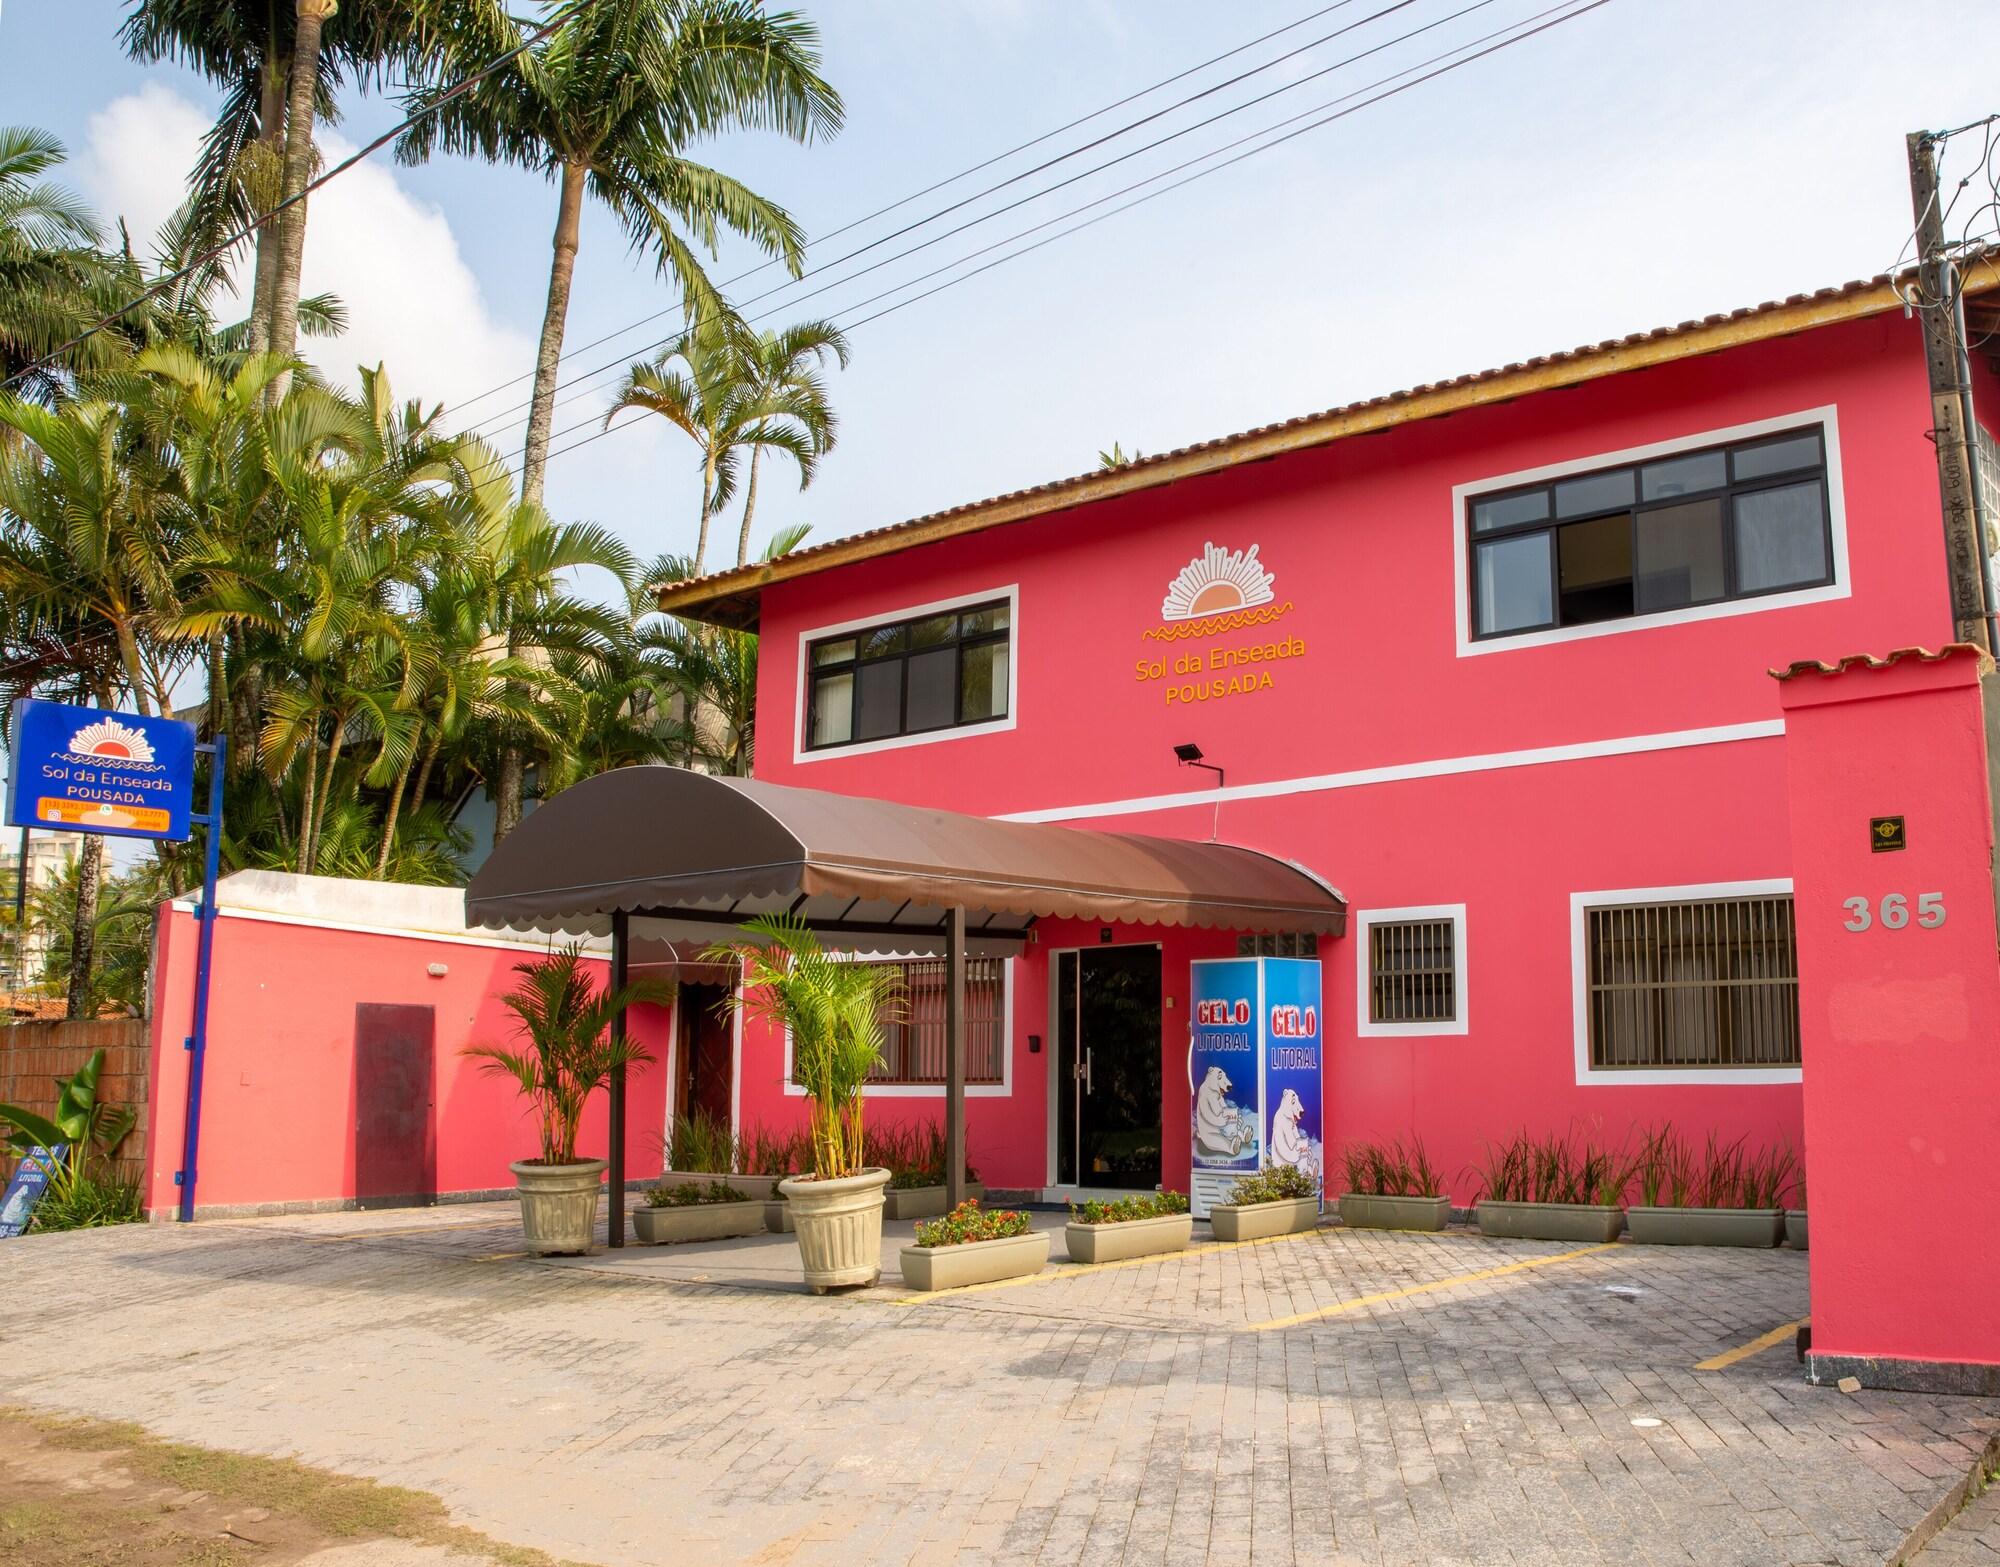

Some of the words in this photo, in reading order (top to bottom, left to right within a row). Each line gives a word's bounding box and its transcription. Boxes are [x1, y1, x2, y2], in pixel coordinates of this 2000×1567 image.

[1135, 655, 1168, 681] Sol
[1174, 651, 1202, 675] da
[1210, 634, 1306, 670] Enseada
[1166, 671, 1274, 705] POUSADA
[42, 764, 69, 780] Sol
[73, 769, 96, 783] da
[101, 771, 173, 792] Enseada
[67, 785, 145, 804] POUSADA
[1842, 891, 1947, 933] 365
[1196, 999, 1251, 1026] GELO
[1271, 1005, 1316, 1038] GELO
[1197, 1032, 1251, 1052] LITORAL
[1271, 1047, 1317, 1070] LITORAL
